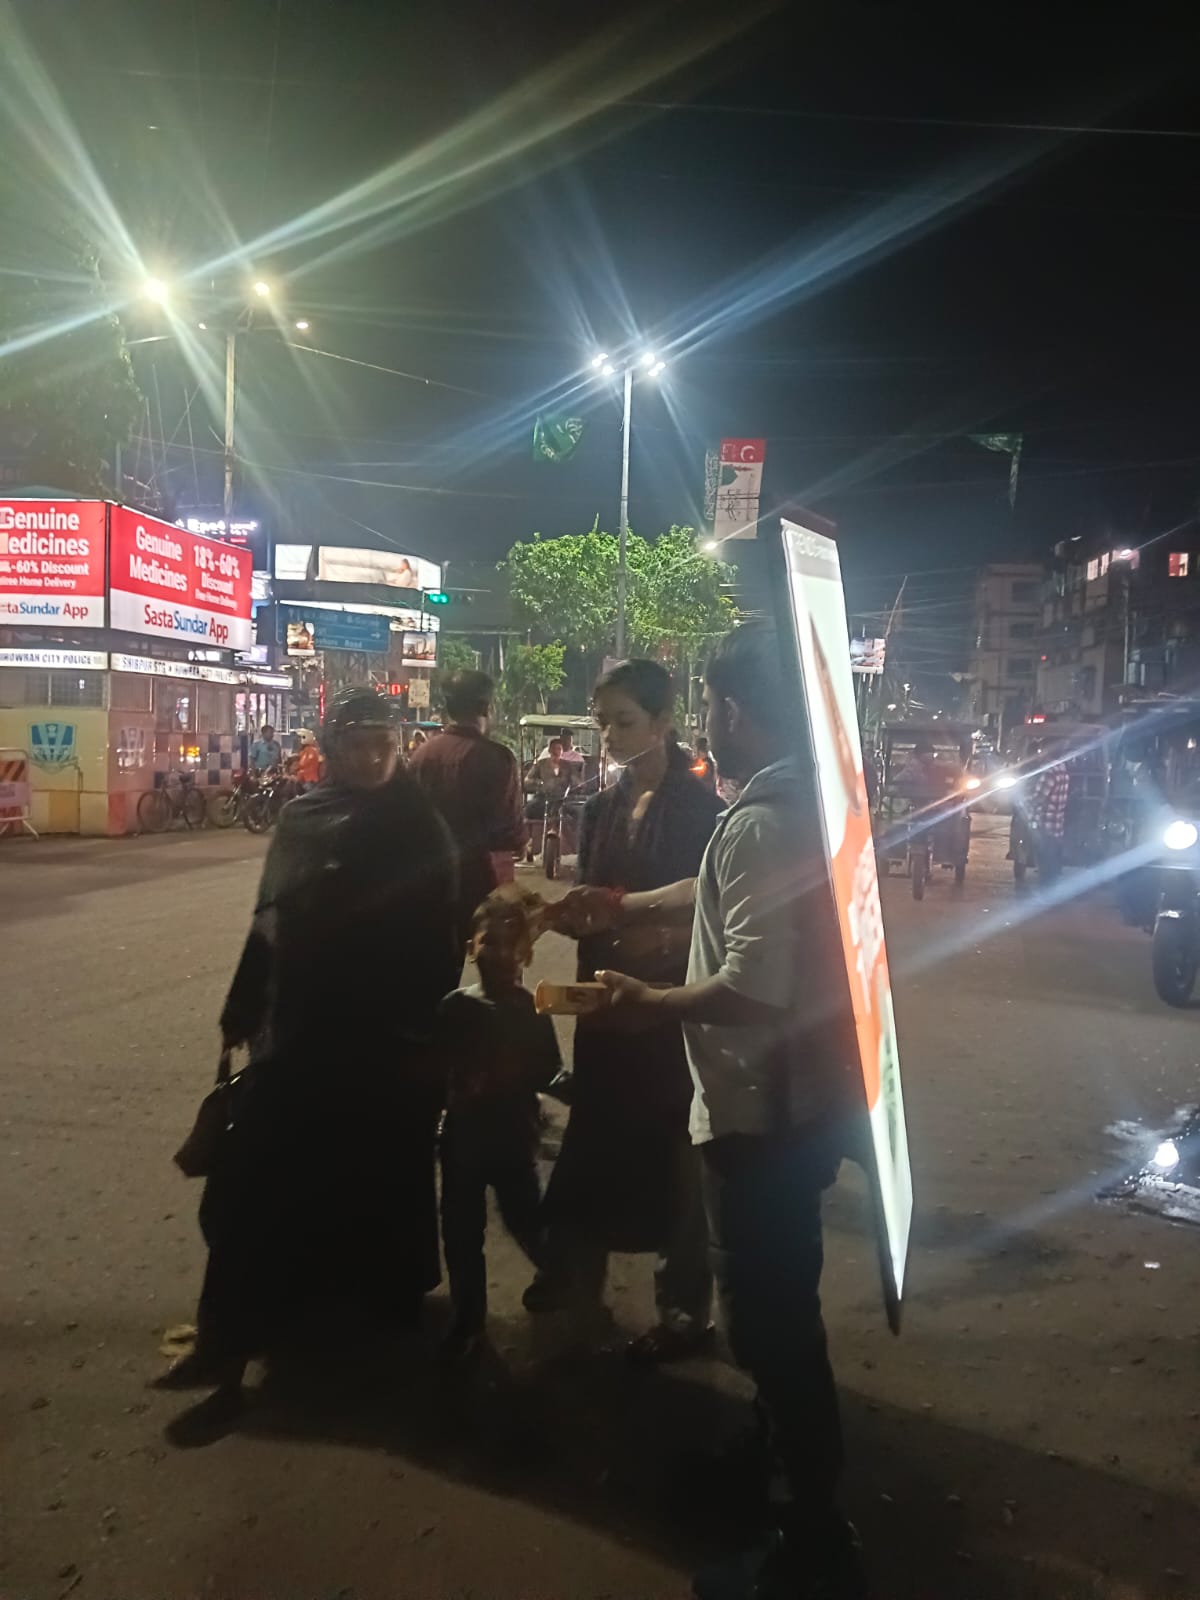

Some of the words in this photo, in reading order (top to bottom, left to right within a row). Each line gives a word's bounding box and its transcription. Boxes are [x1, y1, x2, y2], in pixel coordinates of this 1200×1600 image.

[0, 507, 80, 531] Genuine
[135, 525, 183, 561] Genuine
[41, 560, 89, 576] Discount
[129, 554, 187, 591] Medicines
[0, 602, 60, 616] taSundar
[62, 602, 89, 620] App
[144, 604, 208, 635] SastaSundar
[209, 617, 229, 644] App
[42, 654, 61, 664] CITY
[62, 655, 92, 665] POLICE
